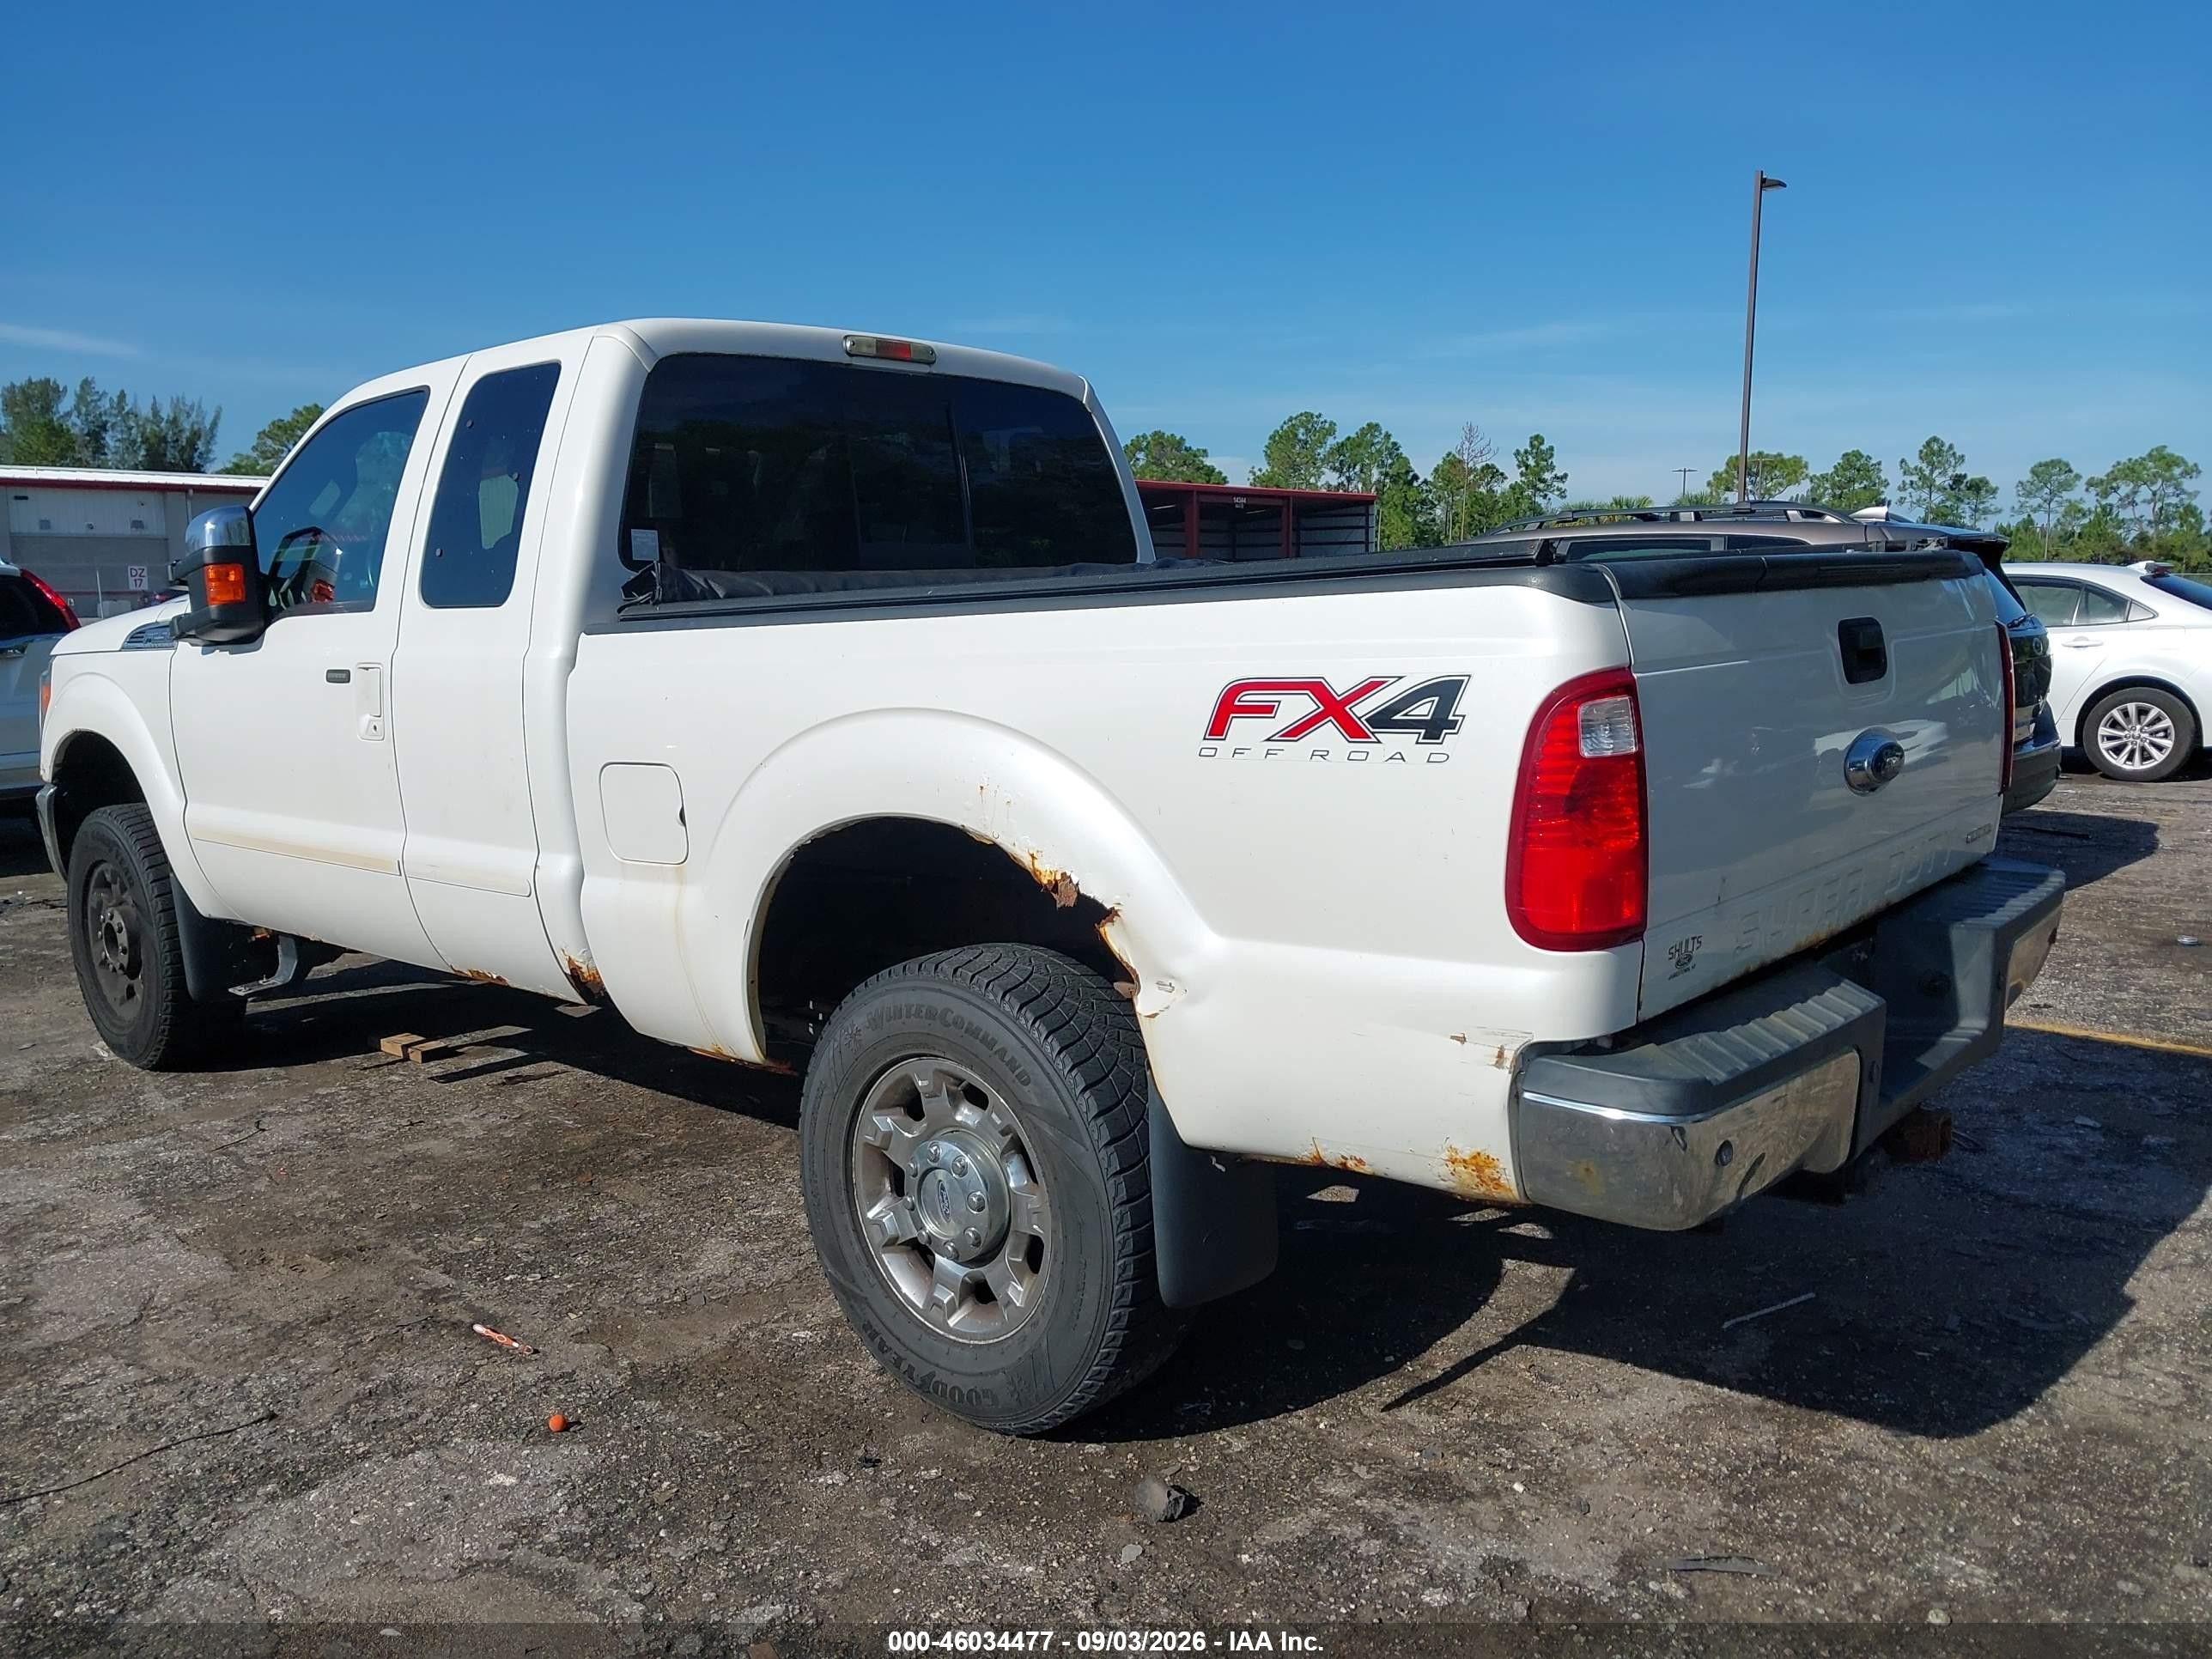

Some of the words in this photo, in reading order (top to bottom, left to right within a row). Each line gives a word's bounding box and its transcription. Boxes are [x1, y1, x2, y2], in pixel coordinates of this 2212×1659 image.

[130, 567, 146, 578] DZ
[134, 579, 143, 588] 17
[1203, 674, 1472, 744] FX4
[1198, 747, 1285, 760] OFF
[1310, 750, 1449, 763] ROAD
[1668, 935, 1703, 961] SHULTS
